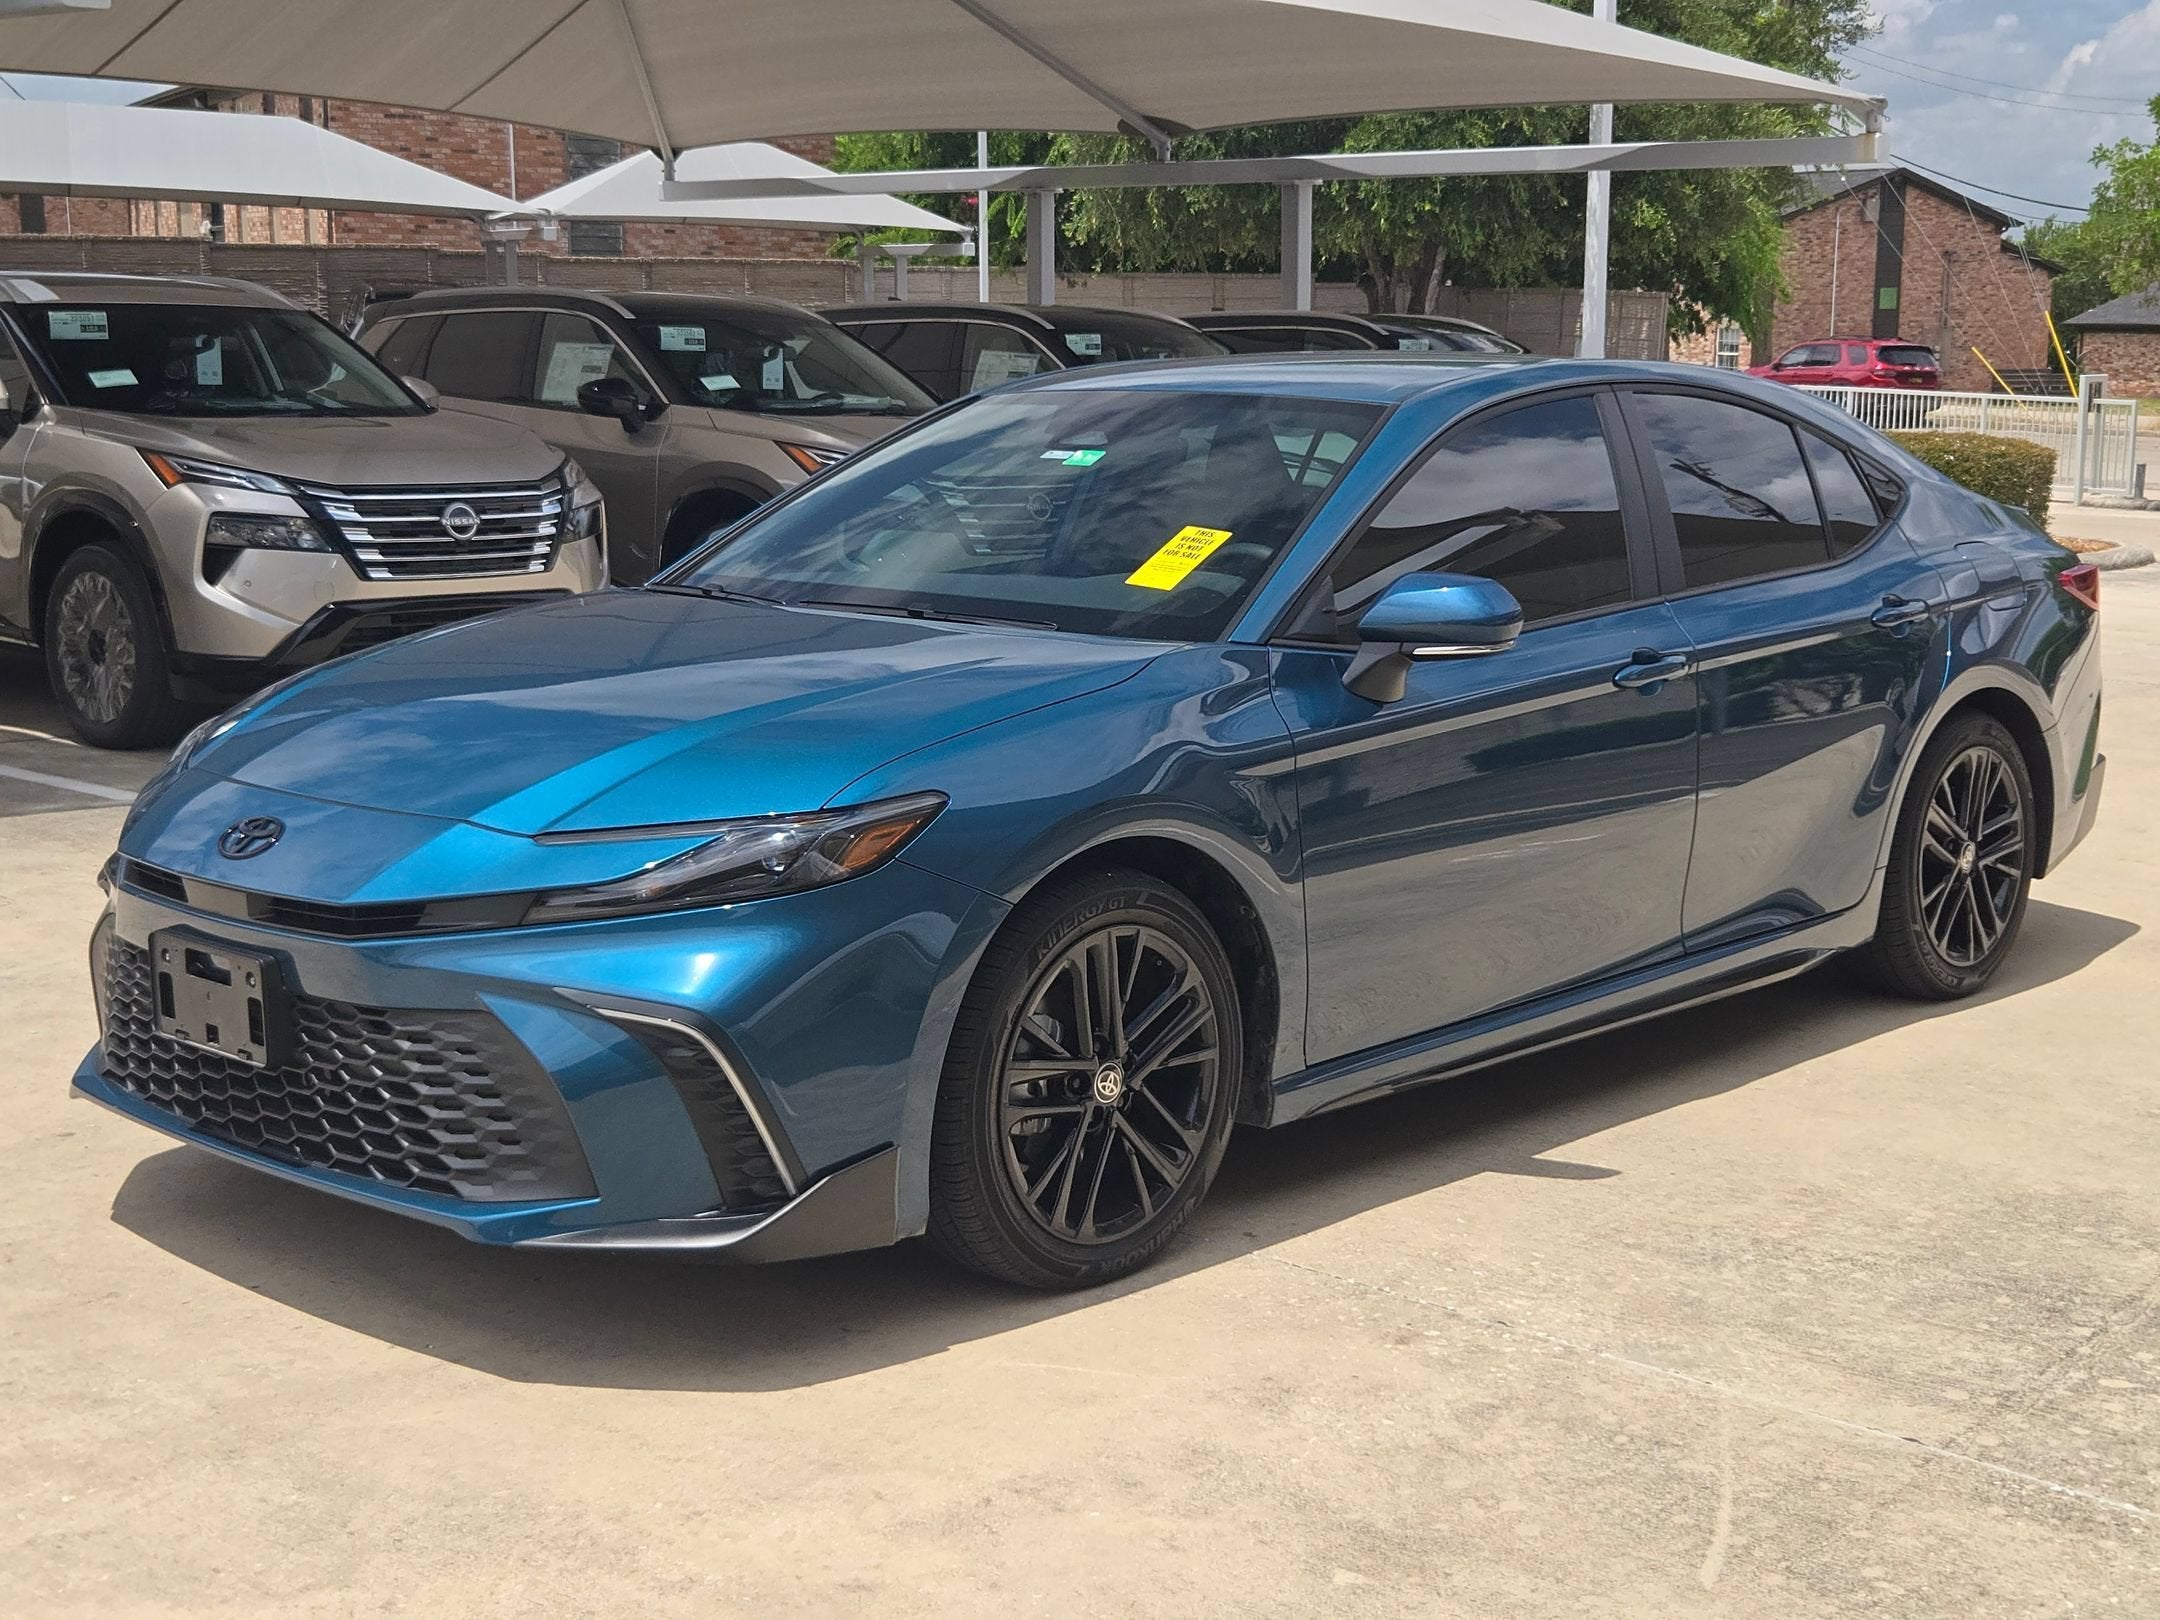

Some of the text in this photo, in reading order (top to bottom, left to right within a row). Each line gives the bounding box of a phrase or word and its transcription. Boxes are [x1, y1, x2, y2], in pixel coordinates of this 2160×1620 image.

[441, 518, 480, 526] NISSAN
[1180, 536, 1214, 545] VEHICLE
[1109, 896, 1126, 909] GT
